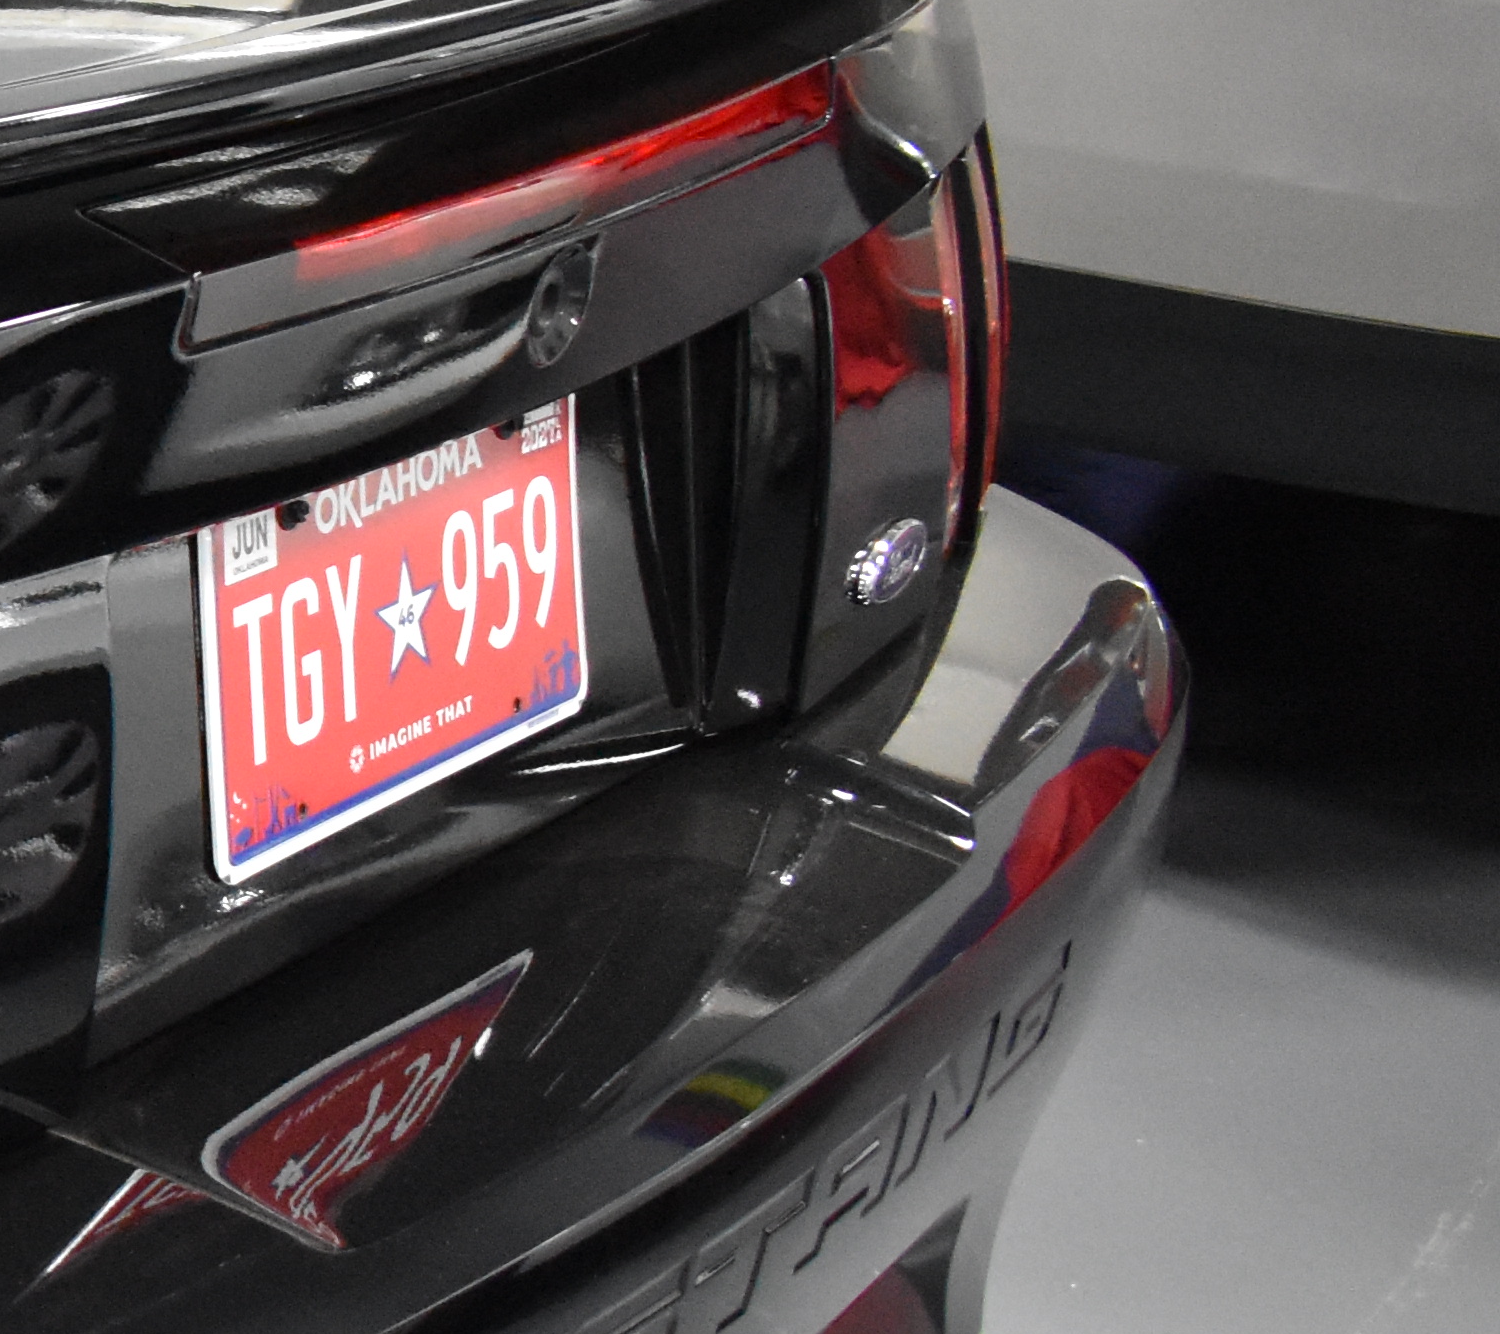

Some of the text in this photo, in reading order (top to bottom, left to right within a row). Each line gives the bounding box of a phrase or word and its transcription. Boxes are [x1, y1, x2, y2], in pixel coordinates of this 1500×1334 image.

[314, 432, 484, 535] OKLAHOMA
[231, 515, 269, 559] JUN
[232, 555, 269, 576] OKLAHOMA
[232, 475, 558, 767] TGY 959
[398, 603, 415, 627] 46
[369, 695, 473, 761] IMAGINE THAT
